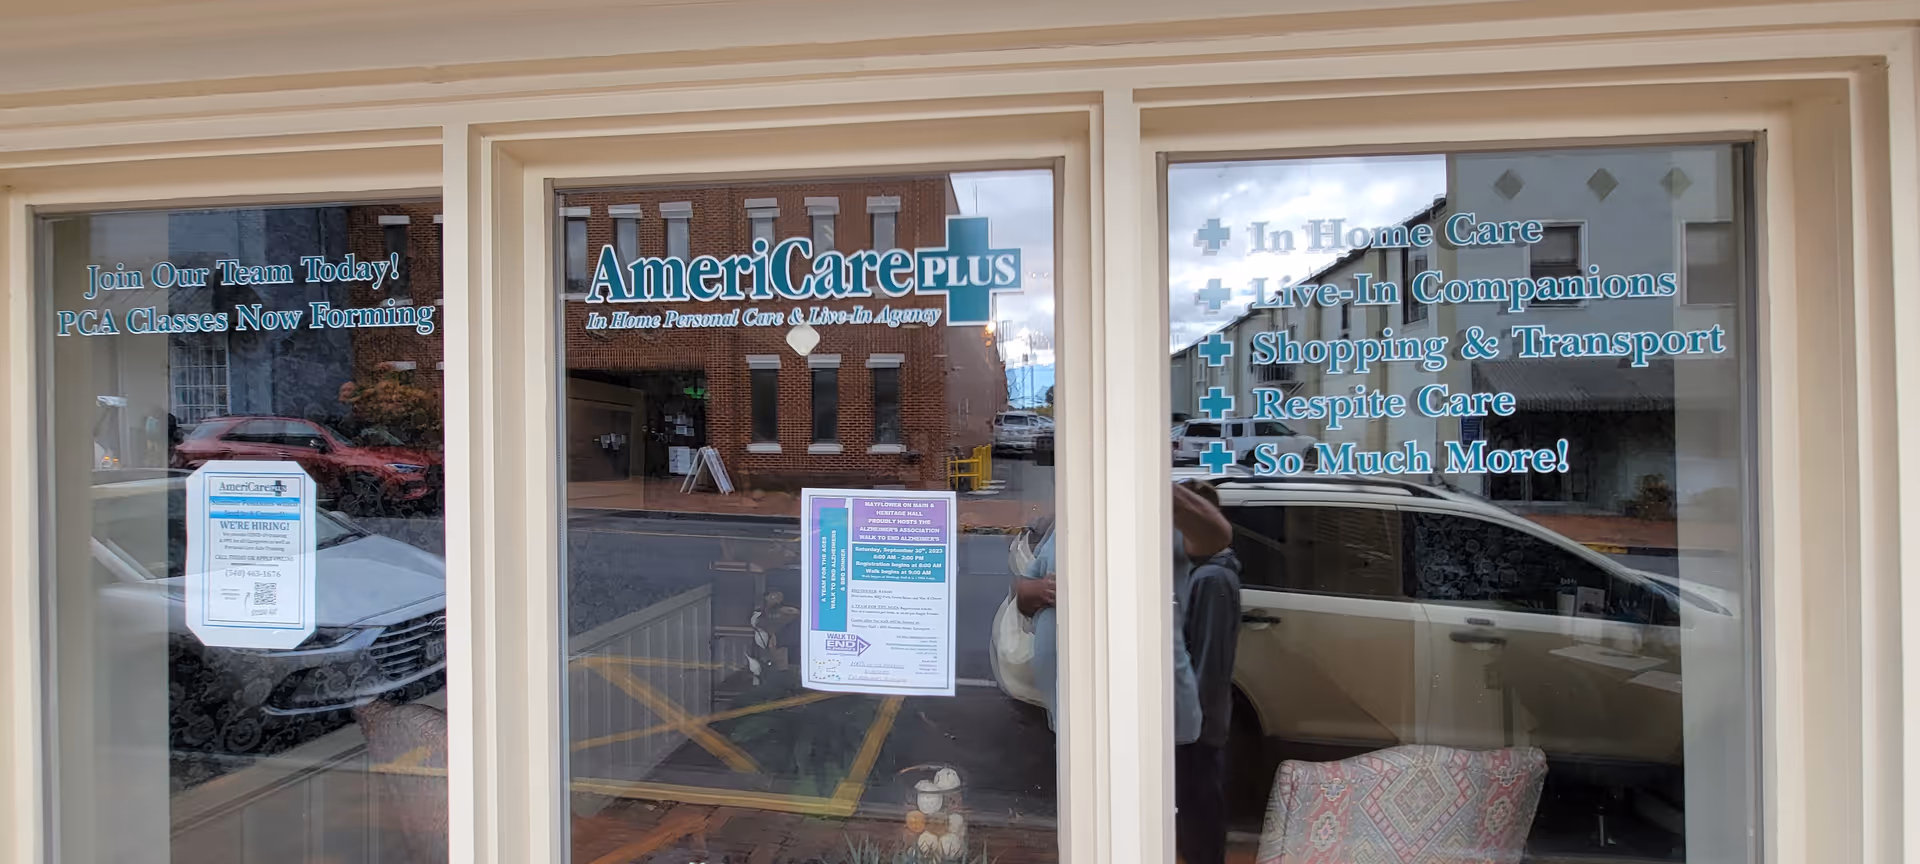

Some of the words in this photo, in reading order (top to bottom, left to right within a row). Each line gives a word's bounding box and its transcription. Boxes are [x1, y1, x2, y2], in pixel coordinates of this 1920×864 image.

[1250, 221, 1296, 252] In
[1306, 218, 1434, 250] Home
[1444, 213, 1544, 245] Care
[85, 263, 144, 299] Join
[151, 262, 209, 288] Our
[216, 259, 293, 287] Team
[301, 253, 399, 290] Today!
[586, 237, 914, 303] AmeriCare
[921, 254, 1017, 287] PLUS
[1252, 271, 1399, 309] Live-In
[1411, 265, 1678, 312] Companions
[57, 310, 119, 336] PCA
[125, 307, 228, 333] Classes
[236, 304, 302, 331] Now
[310, 299, 435, 335] Forming
[586, 313, 607, 330] In
[610, 312, 660, 329] Home
[663, 308, 740, 328] Personal
[742, 307, 784, 326] Care
[788, 308, 803, 325] &
[808, 306, 872, 326] Live-In
[874, 307, 941, 328] Agency
[1252, 328, 1448, 374] Shopping
[1461, 325, 1499, 360] &
[1511, 324, 1726, 368] Transport
[1252, 385, 1407, 430] Respite
[1416, 383, 1516, 418] Care
[1253, 444, 1303, 476] So
[1315, 439, 1433, 475] Much
[1445, 439, 1569, 474] More!
[219, 481, 270, 492] AmeriCare
[220, 521, 249, 530] WE'RE
[251, 521, 290, 531] HIRING!
[830, 582, 836, 591] TO
